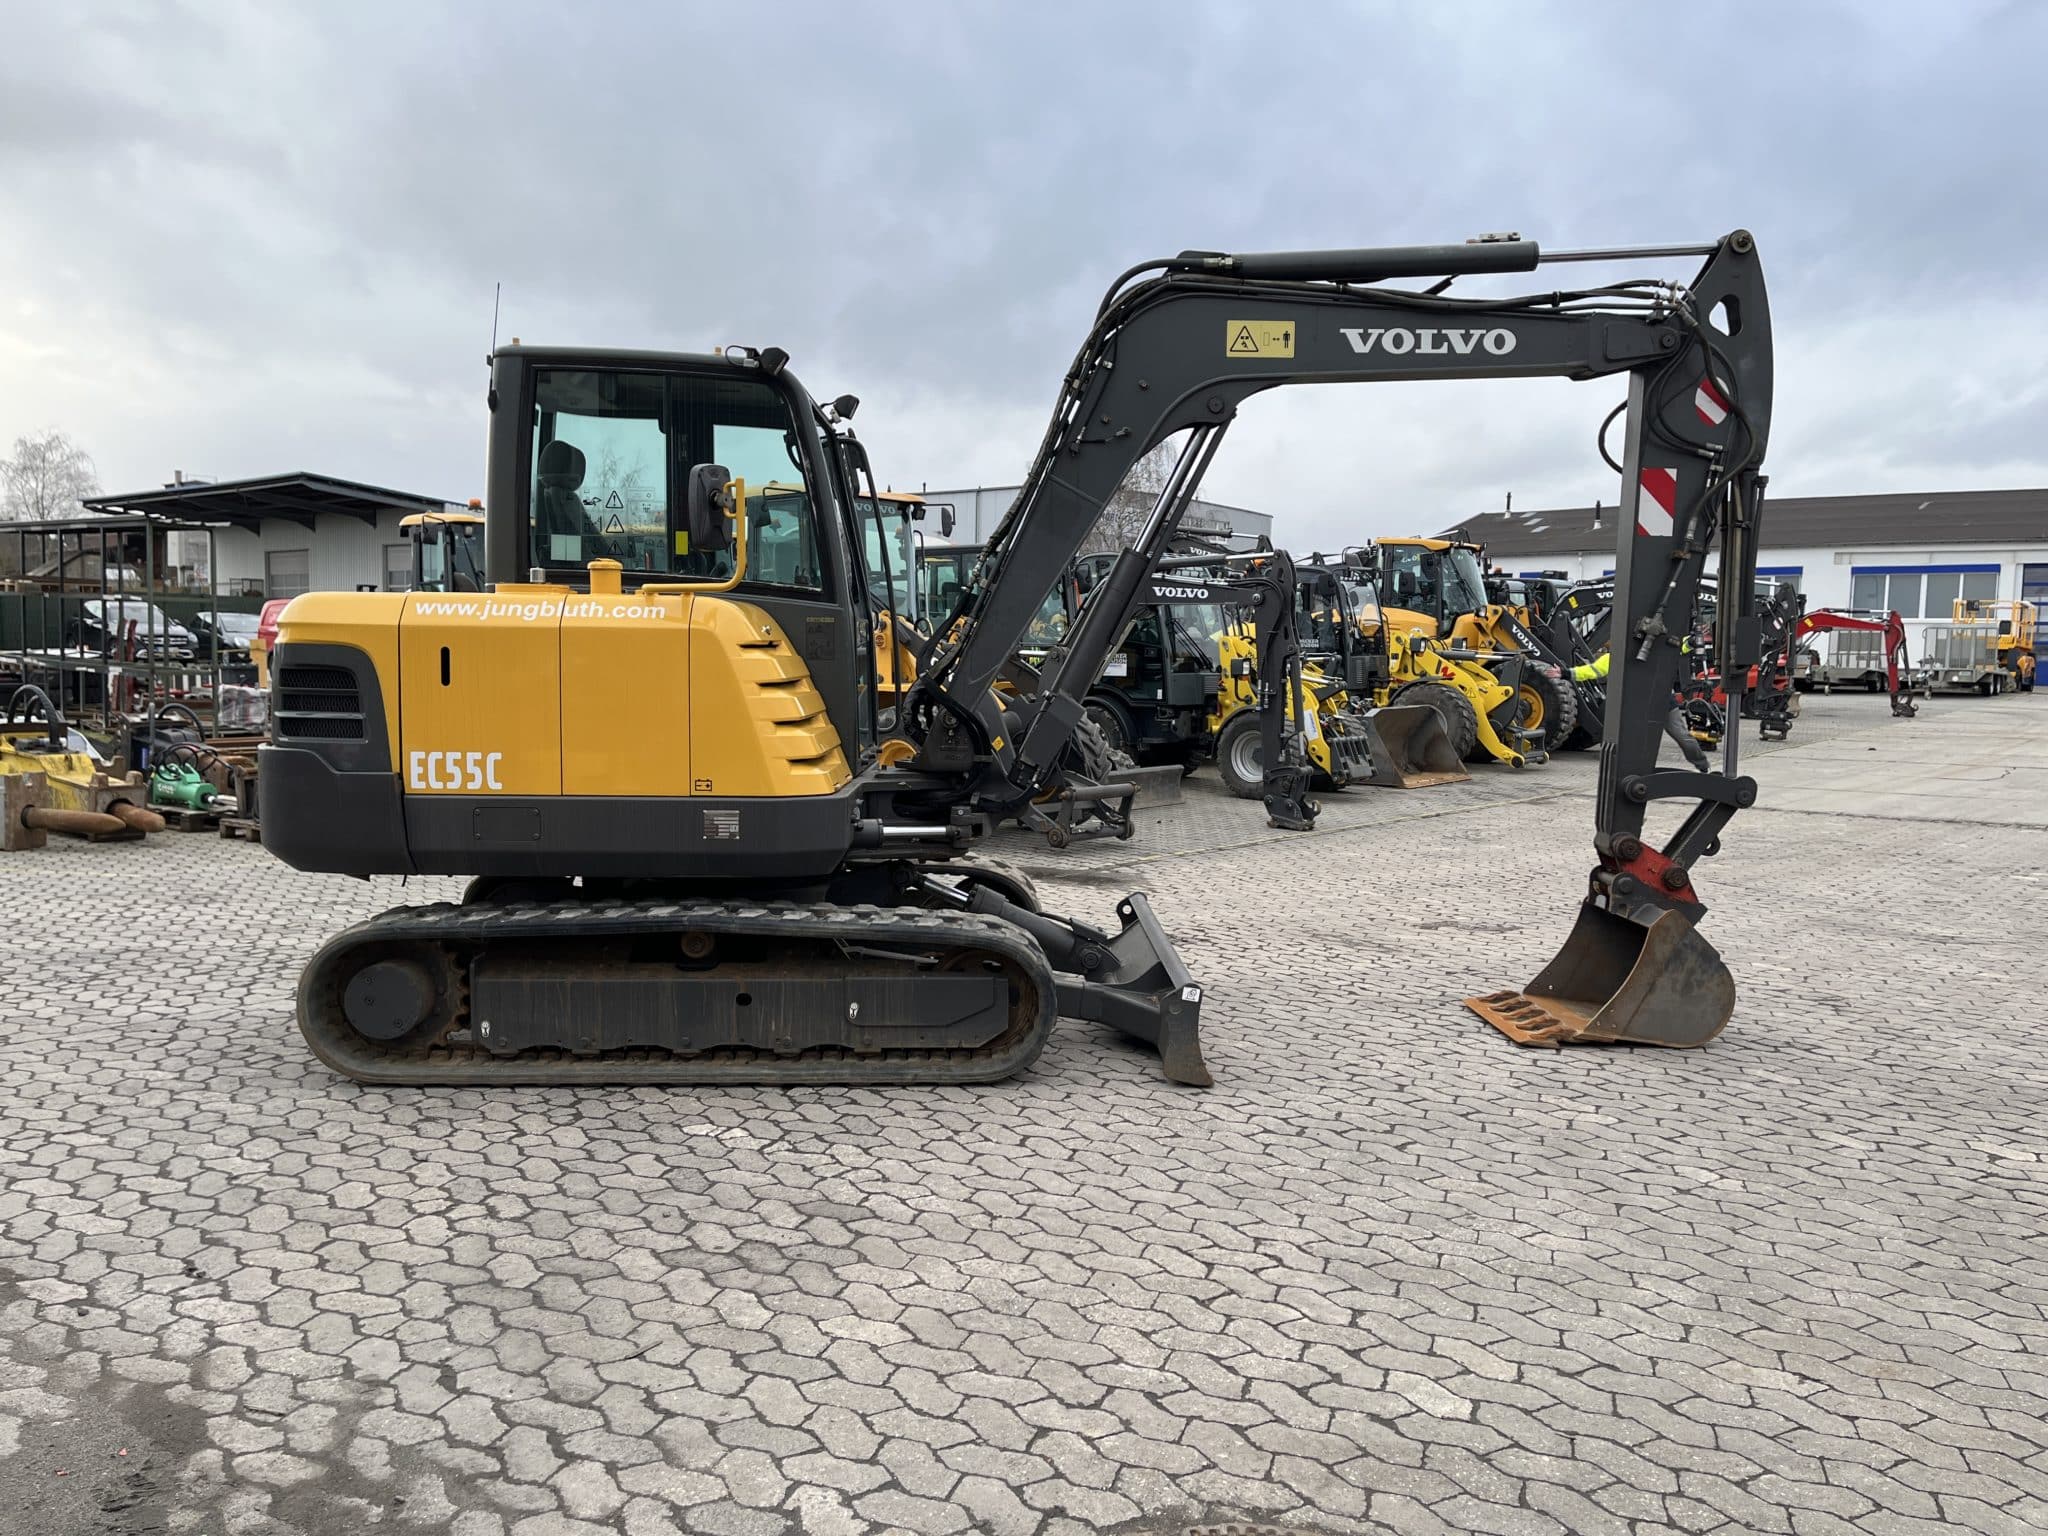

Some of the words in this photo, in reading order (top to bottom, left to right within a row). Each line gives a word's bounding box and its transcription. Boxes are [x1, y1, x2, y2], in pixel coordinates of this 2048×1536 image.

[1340, 328, 1517, 355] VOLVO
[855, 503, 896, 514] VOVO
[1152, 586, 1209, 599] VOLVO
[415, 600, 666, 621] www.jungbluth.com
[1512, 624, 1541, 656] VOLVO
[410, 751, 503, 790] EC55C
